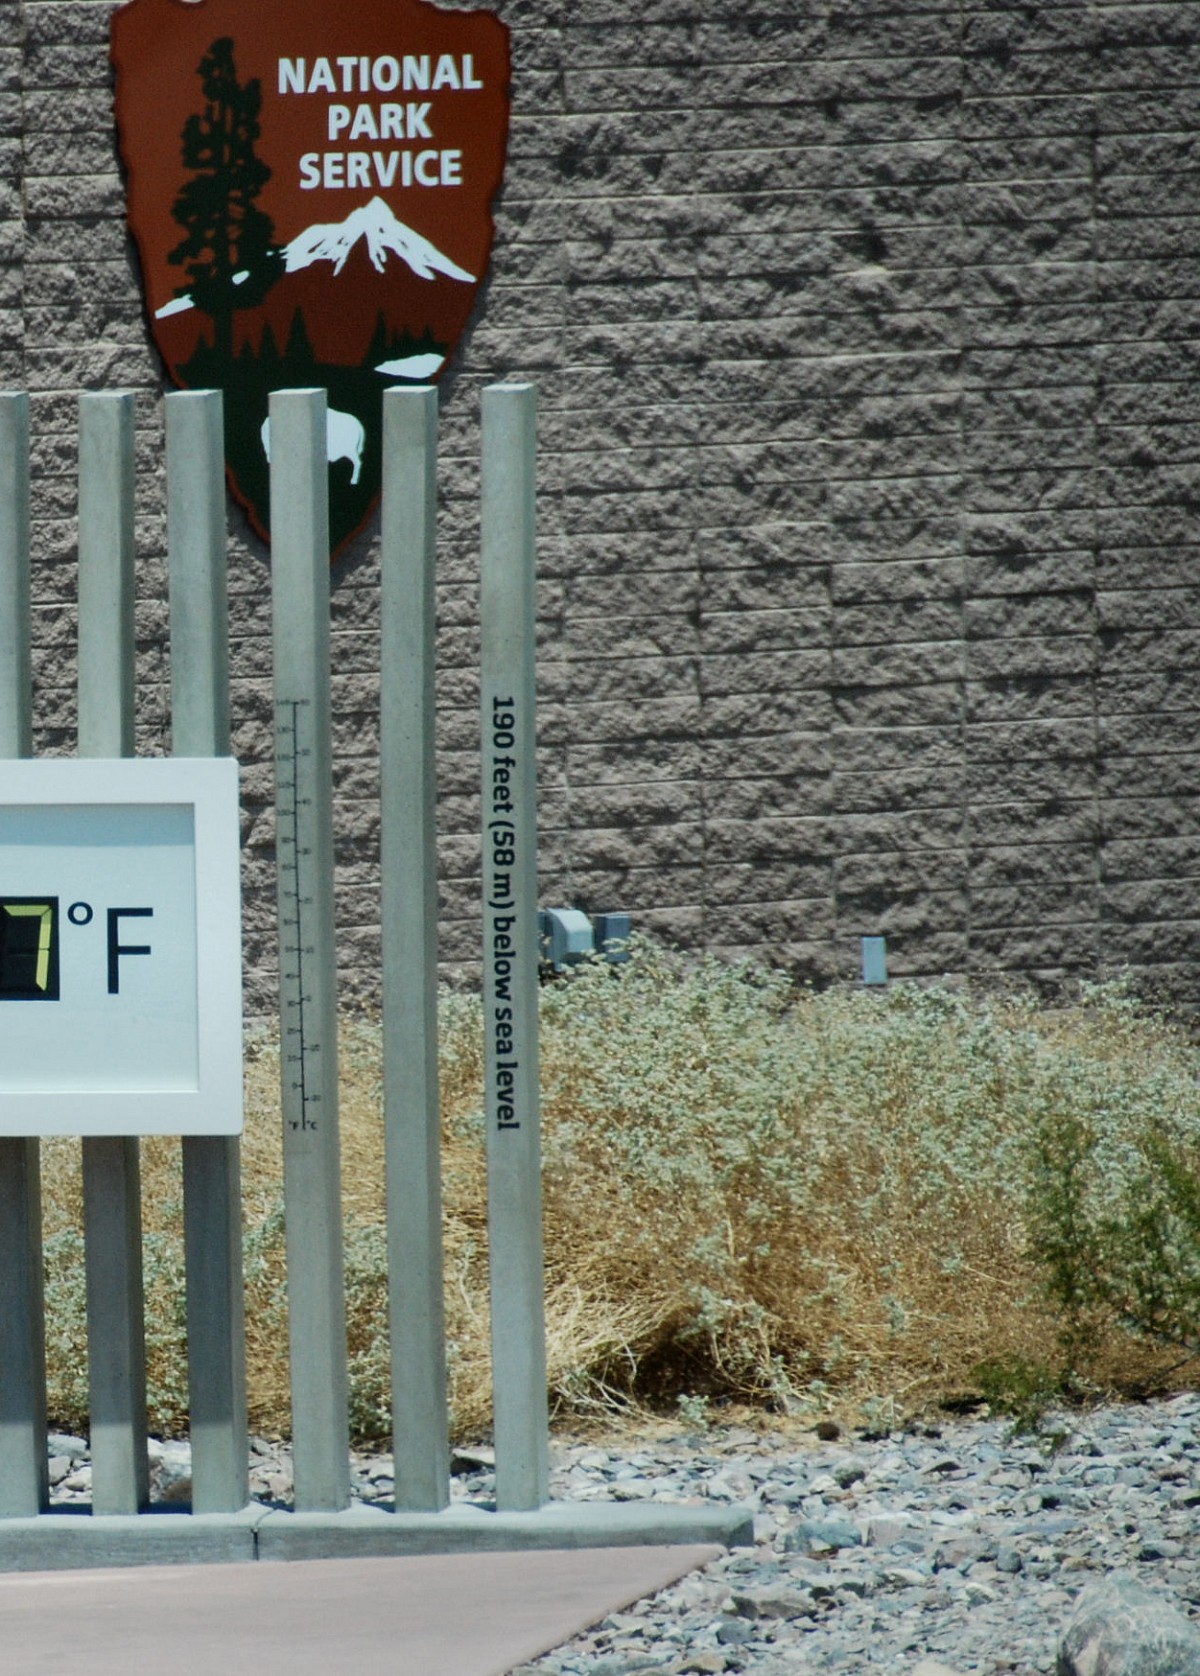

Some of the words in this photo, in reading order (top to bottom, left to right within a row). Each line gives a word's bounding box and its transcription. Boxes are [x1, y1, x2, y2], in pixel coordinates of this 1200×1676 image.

[277, 54, 484, 94] NATIONAL
[327, 102, 433, 141] PARK
[299, 149, 463, 190] SERVICE
[492, 696, 516, 749] 190
[492, 756, 516, 814] feet
[488, 820, 516, 867] (58
[488, 873, 516, 910] m)
[492, 916, 517, 1001] below
[494, 1007, 514, 1056] sea
[495, 1061, 521, 1131] level
